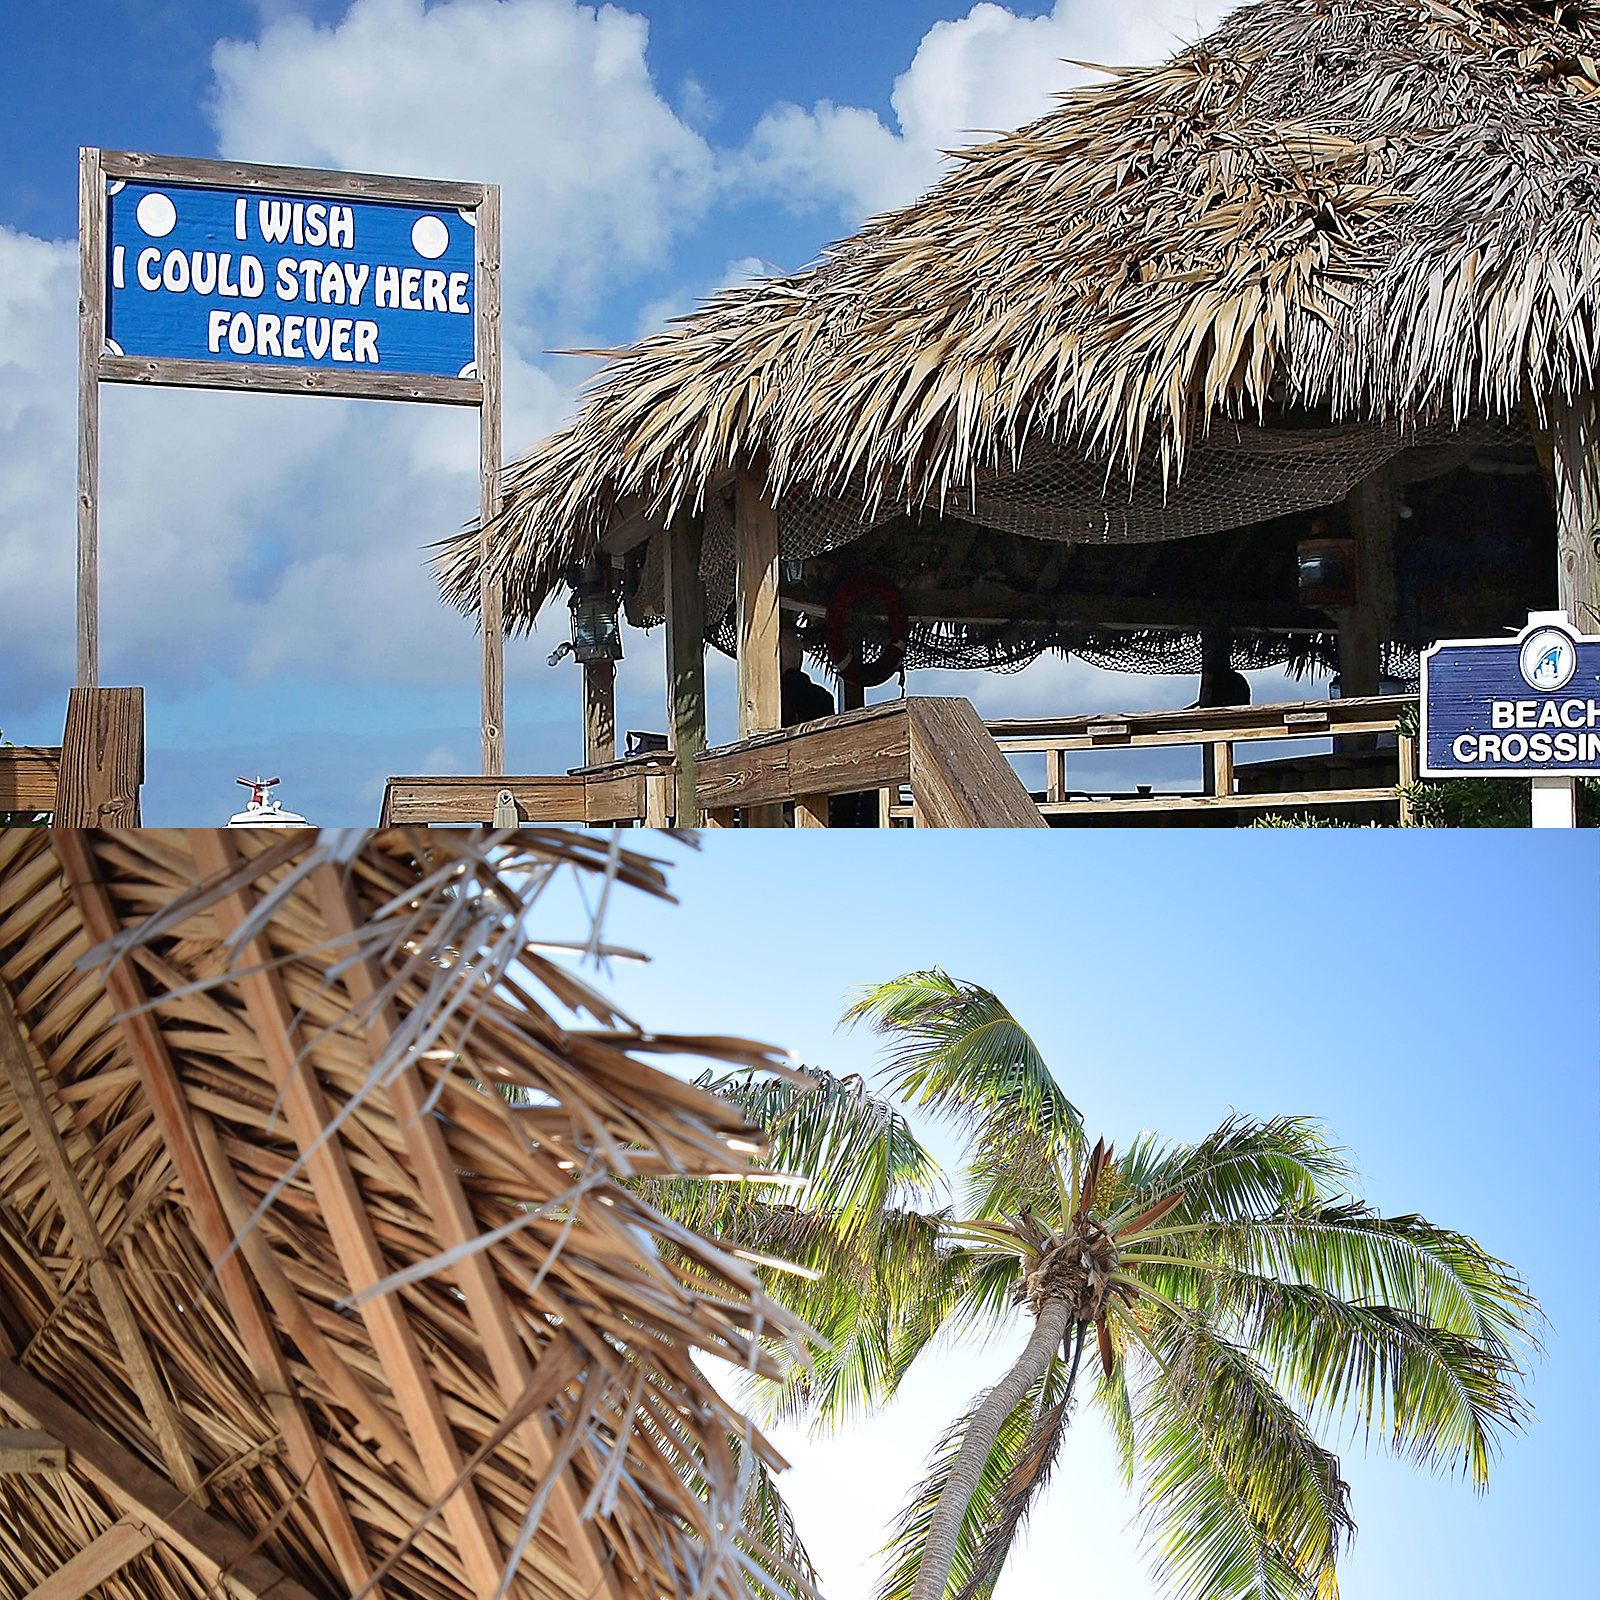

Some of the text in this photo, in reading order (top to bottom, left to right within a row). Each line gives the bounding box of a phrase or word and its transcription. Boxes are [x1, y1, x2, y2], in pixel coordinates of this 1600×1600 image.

[235, 198, 355, 249] I WISH
[113, 246, 471, 314] I COULD STAY HERE
[208, 309, 380, 364] FOREVER
